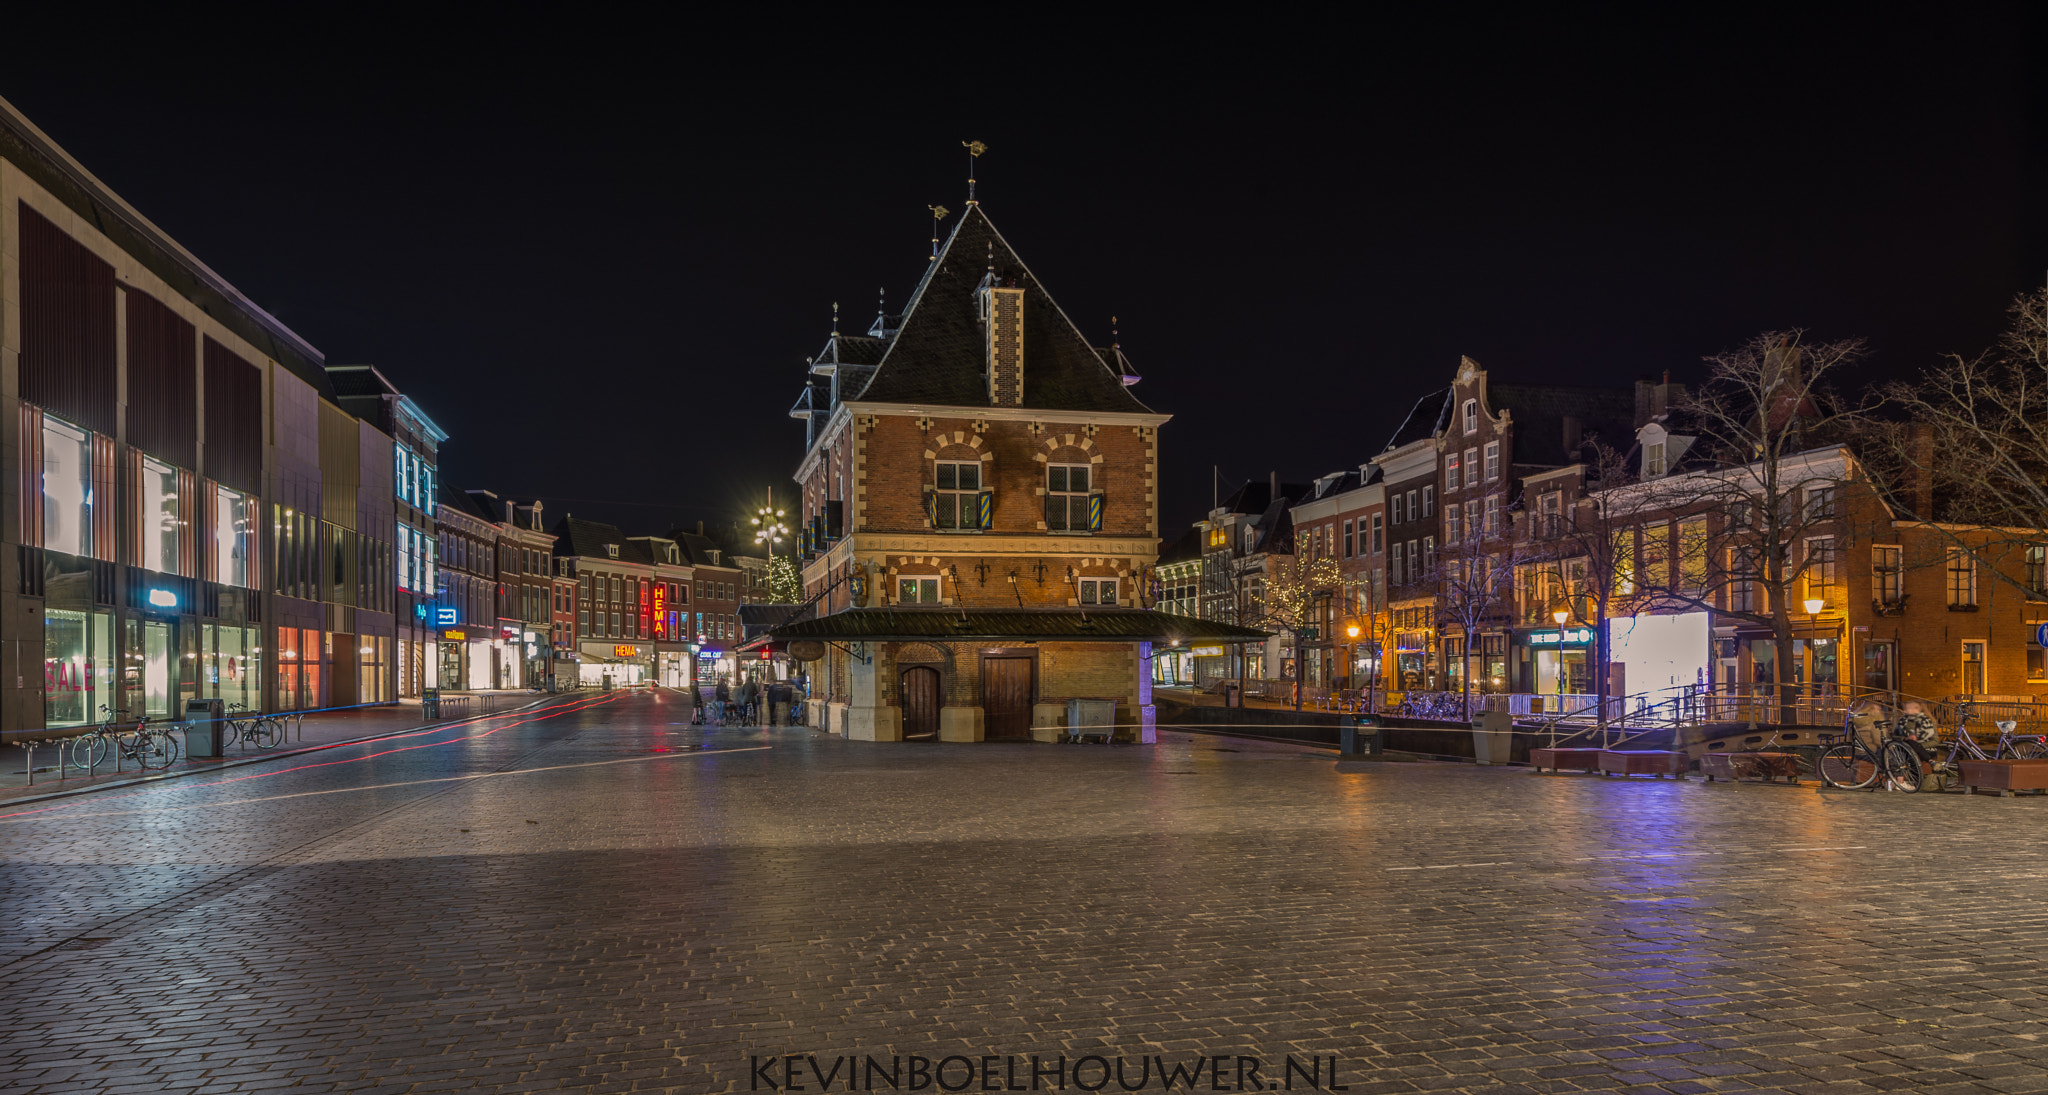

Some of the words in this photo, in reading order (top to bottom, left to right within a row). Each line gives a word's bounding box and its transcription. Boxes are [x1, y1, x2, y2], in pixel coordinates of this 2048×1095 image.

[654, 588, 664, 632] HEMA
[614, 645, 636, 657] HEMA
[45, 662, 95, 693] SALE
